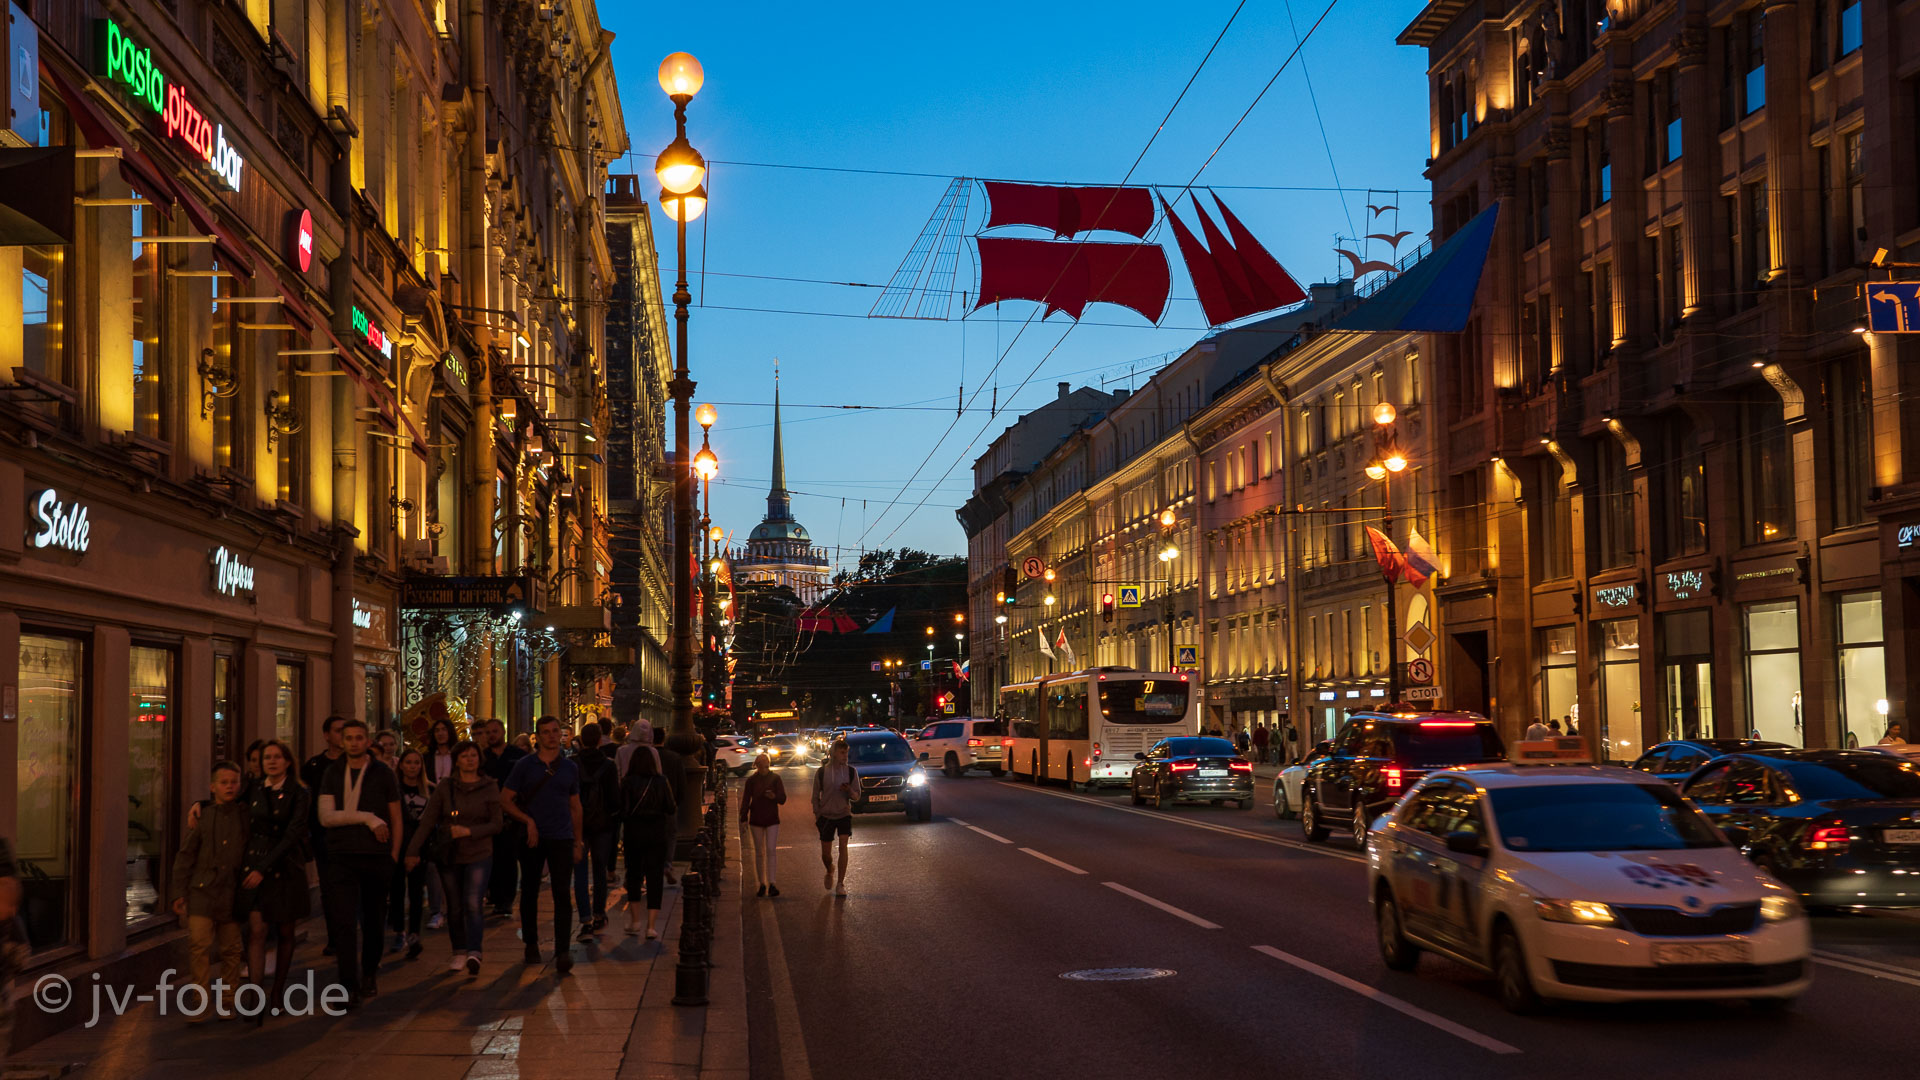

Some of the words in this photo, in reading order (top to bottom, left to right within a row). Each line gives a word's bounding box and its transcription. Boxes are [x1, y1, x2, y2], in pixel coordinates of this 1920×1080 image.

[107, 18, 243, 193] pasta.pizza.bar
[35, 488, 90, 552] Stolle
[1143, 681, 1155, 694] 27
[1411, 687, 1439, 699] СТОП
